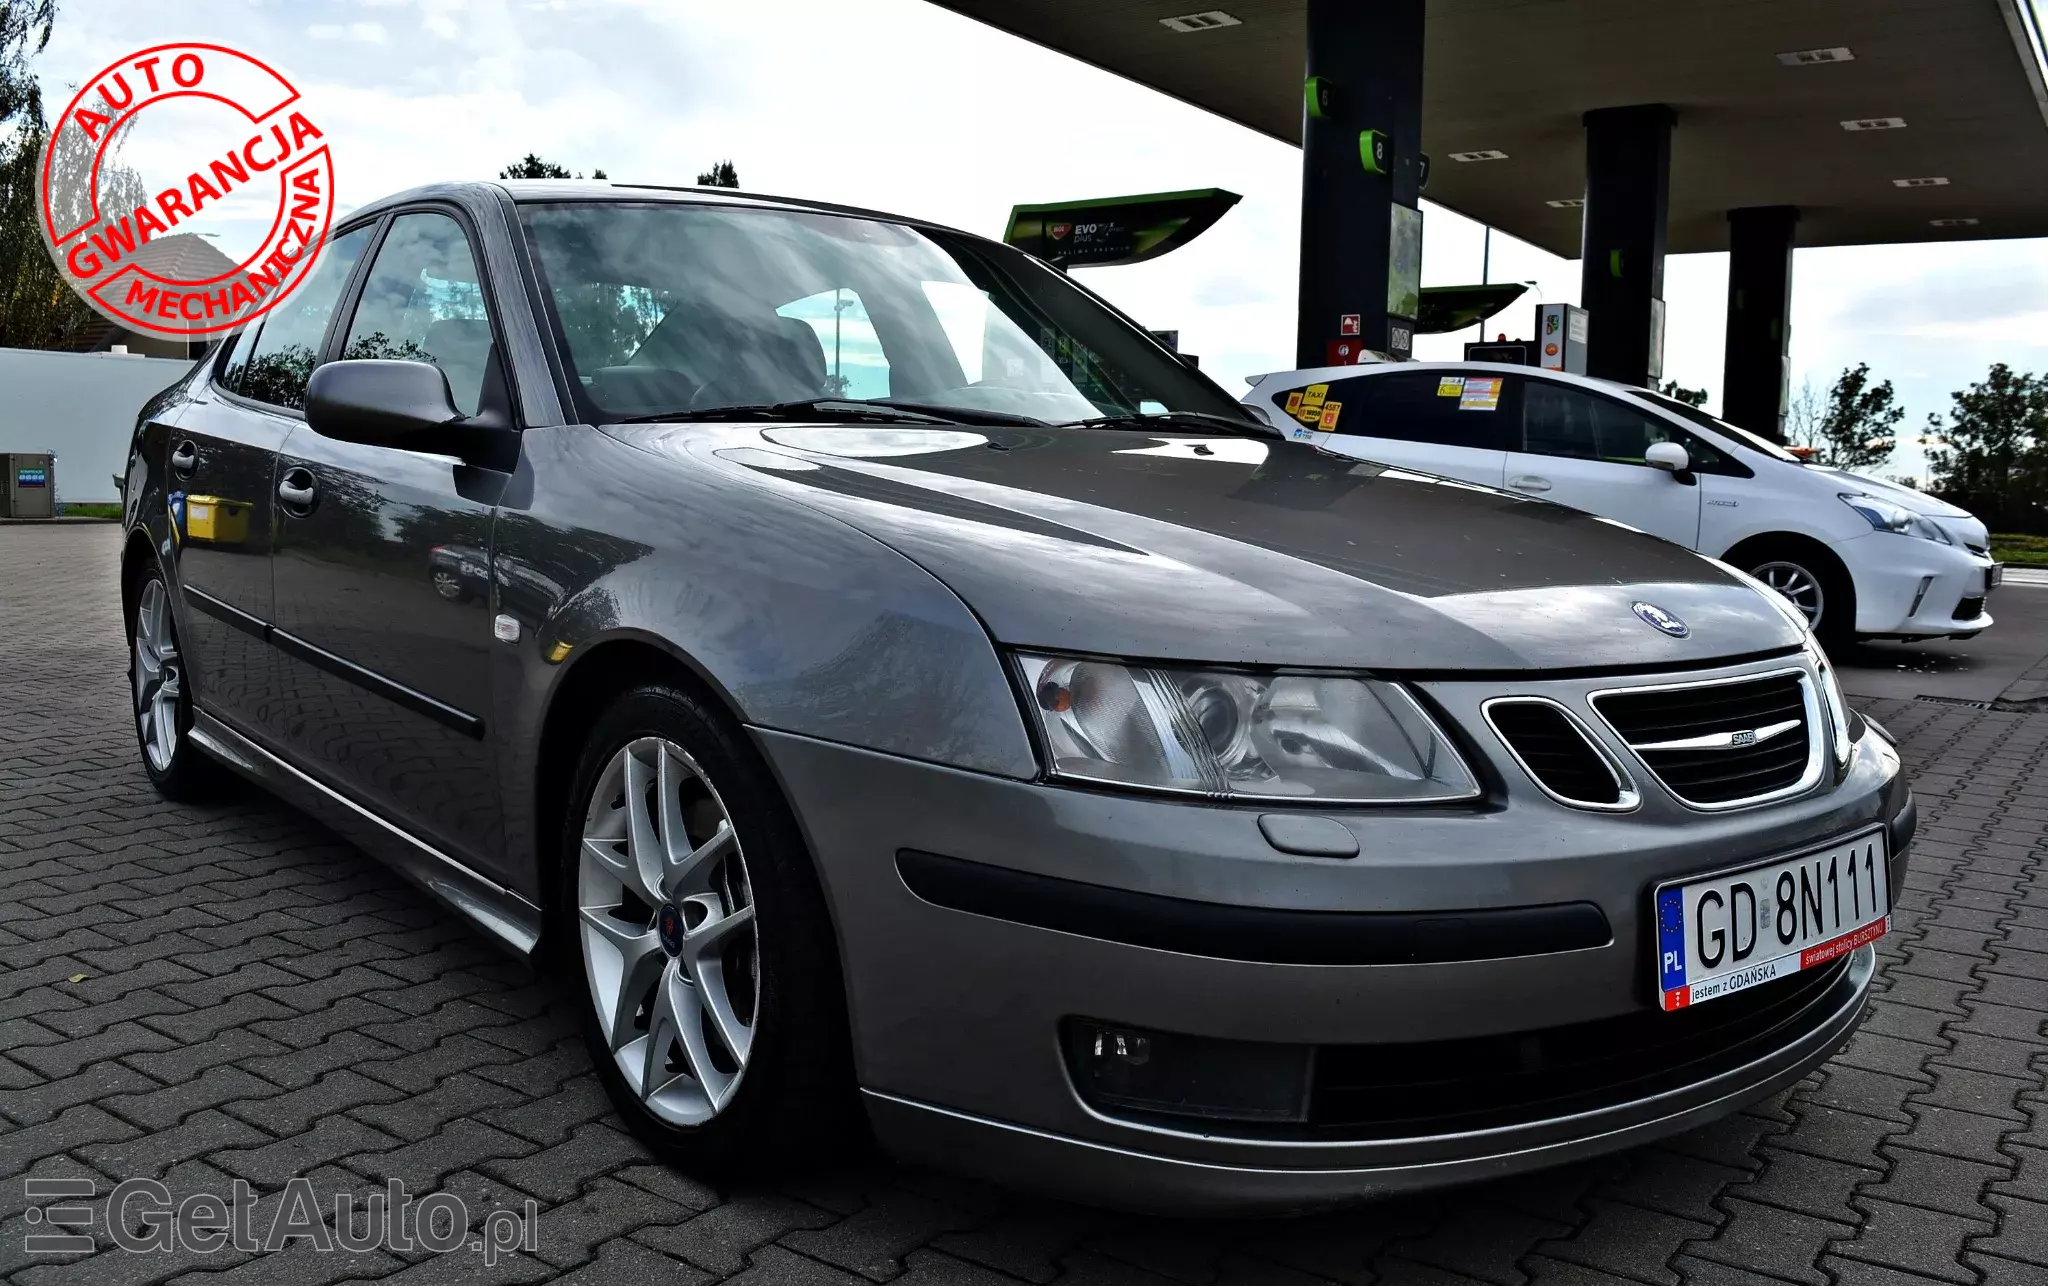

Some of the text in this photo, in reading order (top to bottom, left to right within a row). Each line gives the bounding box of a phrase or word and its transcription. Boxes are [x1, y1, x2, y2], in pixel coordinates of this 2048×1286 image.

[1376, 142, 1383, 159] 8
[1075, 223, 1097, 235] EVO
[1074, 234, 1092, 243] plus
[1307, 391, 1324, 399] TAXI
[1733, 732, 1753, 745] SAAB
[1696, 842, 1877, 969] GD 8N111
[1805, 921, 1883, 965] światowej stolicy BURSZTYNU
[1664, 952, 1682, 973] PL
[1692, 964, 1777, 1002] jestem z GDAŃSKA
